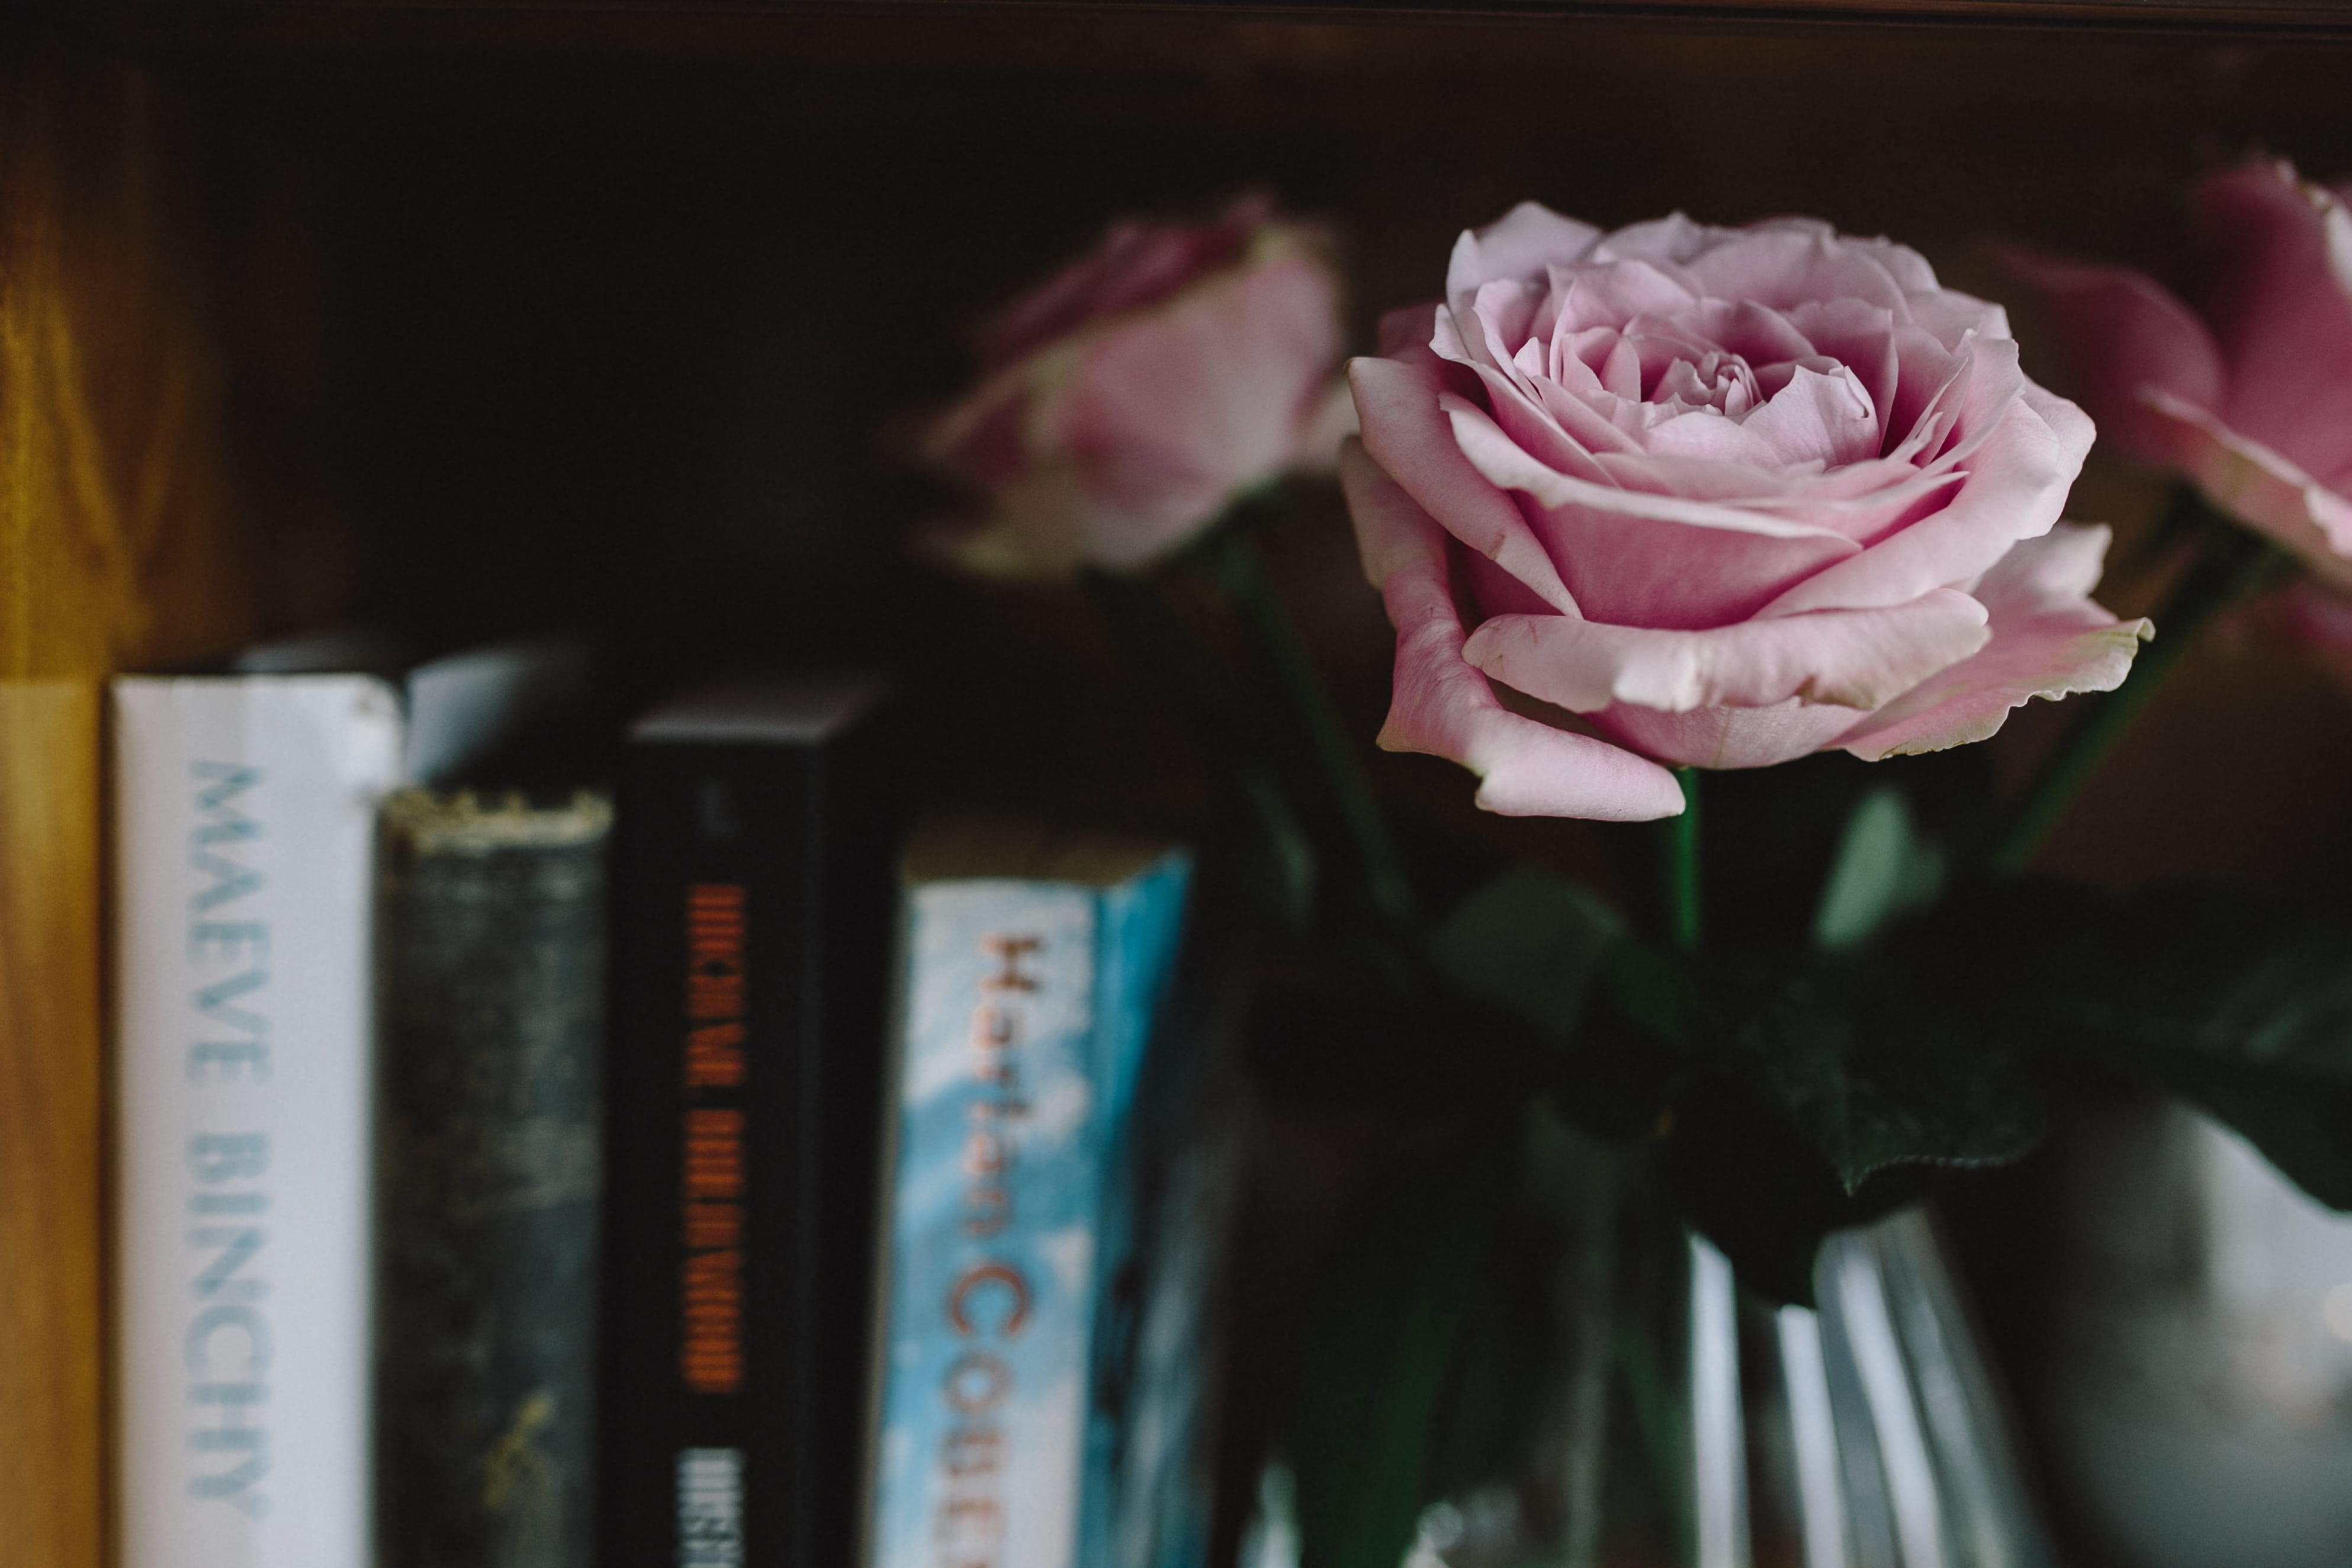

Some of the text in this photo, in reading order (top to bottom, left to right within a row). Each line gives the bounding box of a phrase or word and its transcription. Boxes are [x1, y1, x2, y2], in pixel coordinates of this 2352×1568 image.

[185, 761, 275, 1519] MAEVE BINCHY
[934, 933, 1045, 1568] Harlan COBE
